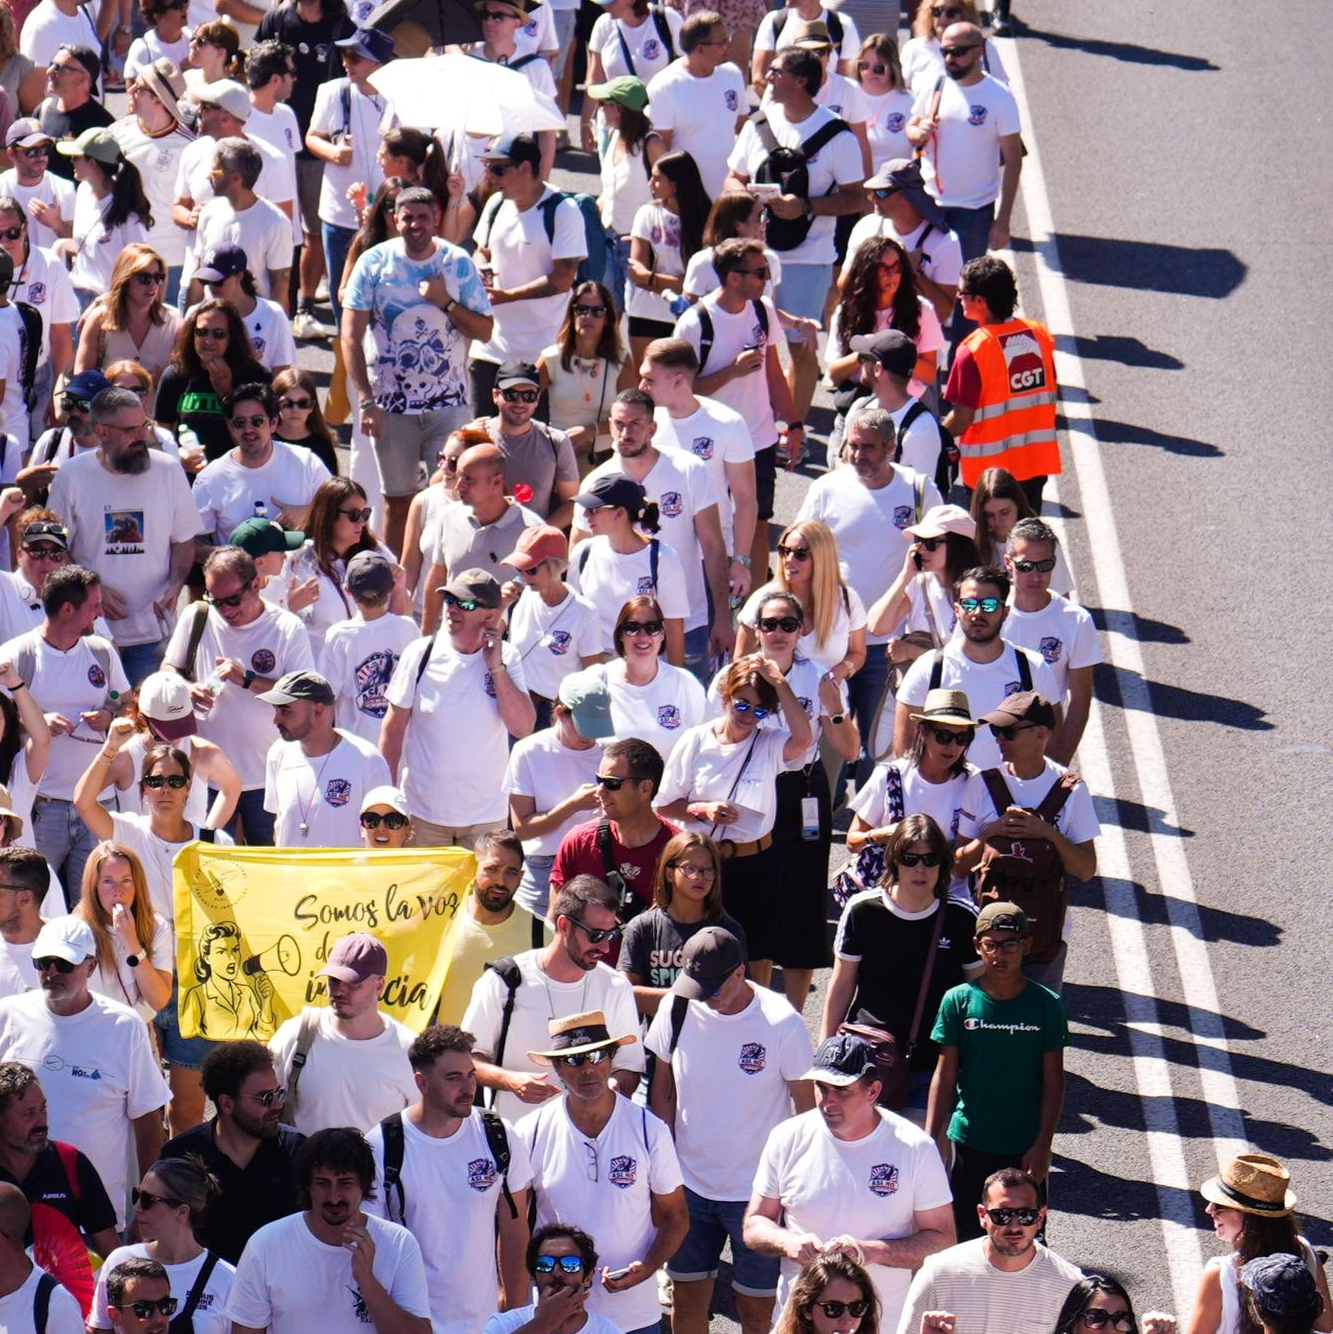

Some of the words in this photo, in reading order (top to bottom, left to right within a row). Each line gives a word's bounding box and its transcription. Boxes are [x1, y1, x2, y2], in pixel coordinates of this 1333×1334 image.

[1010, 369, 1044, 390] CGT
[293, 893, 379, 932] Somos
[385, 883, 414, 923] la
[418, 892, 461, 921] voz
[964, 1018, 1042, 1035] Champion
